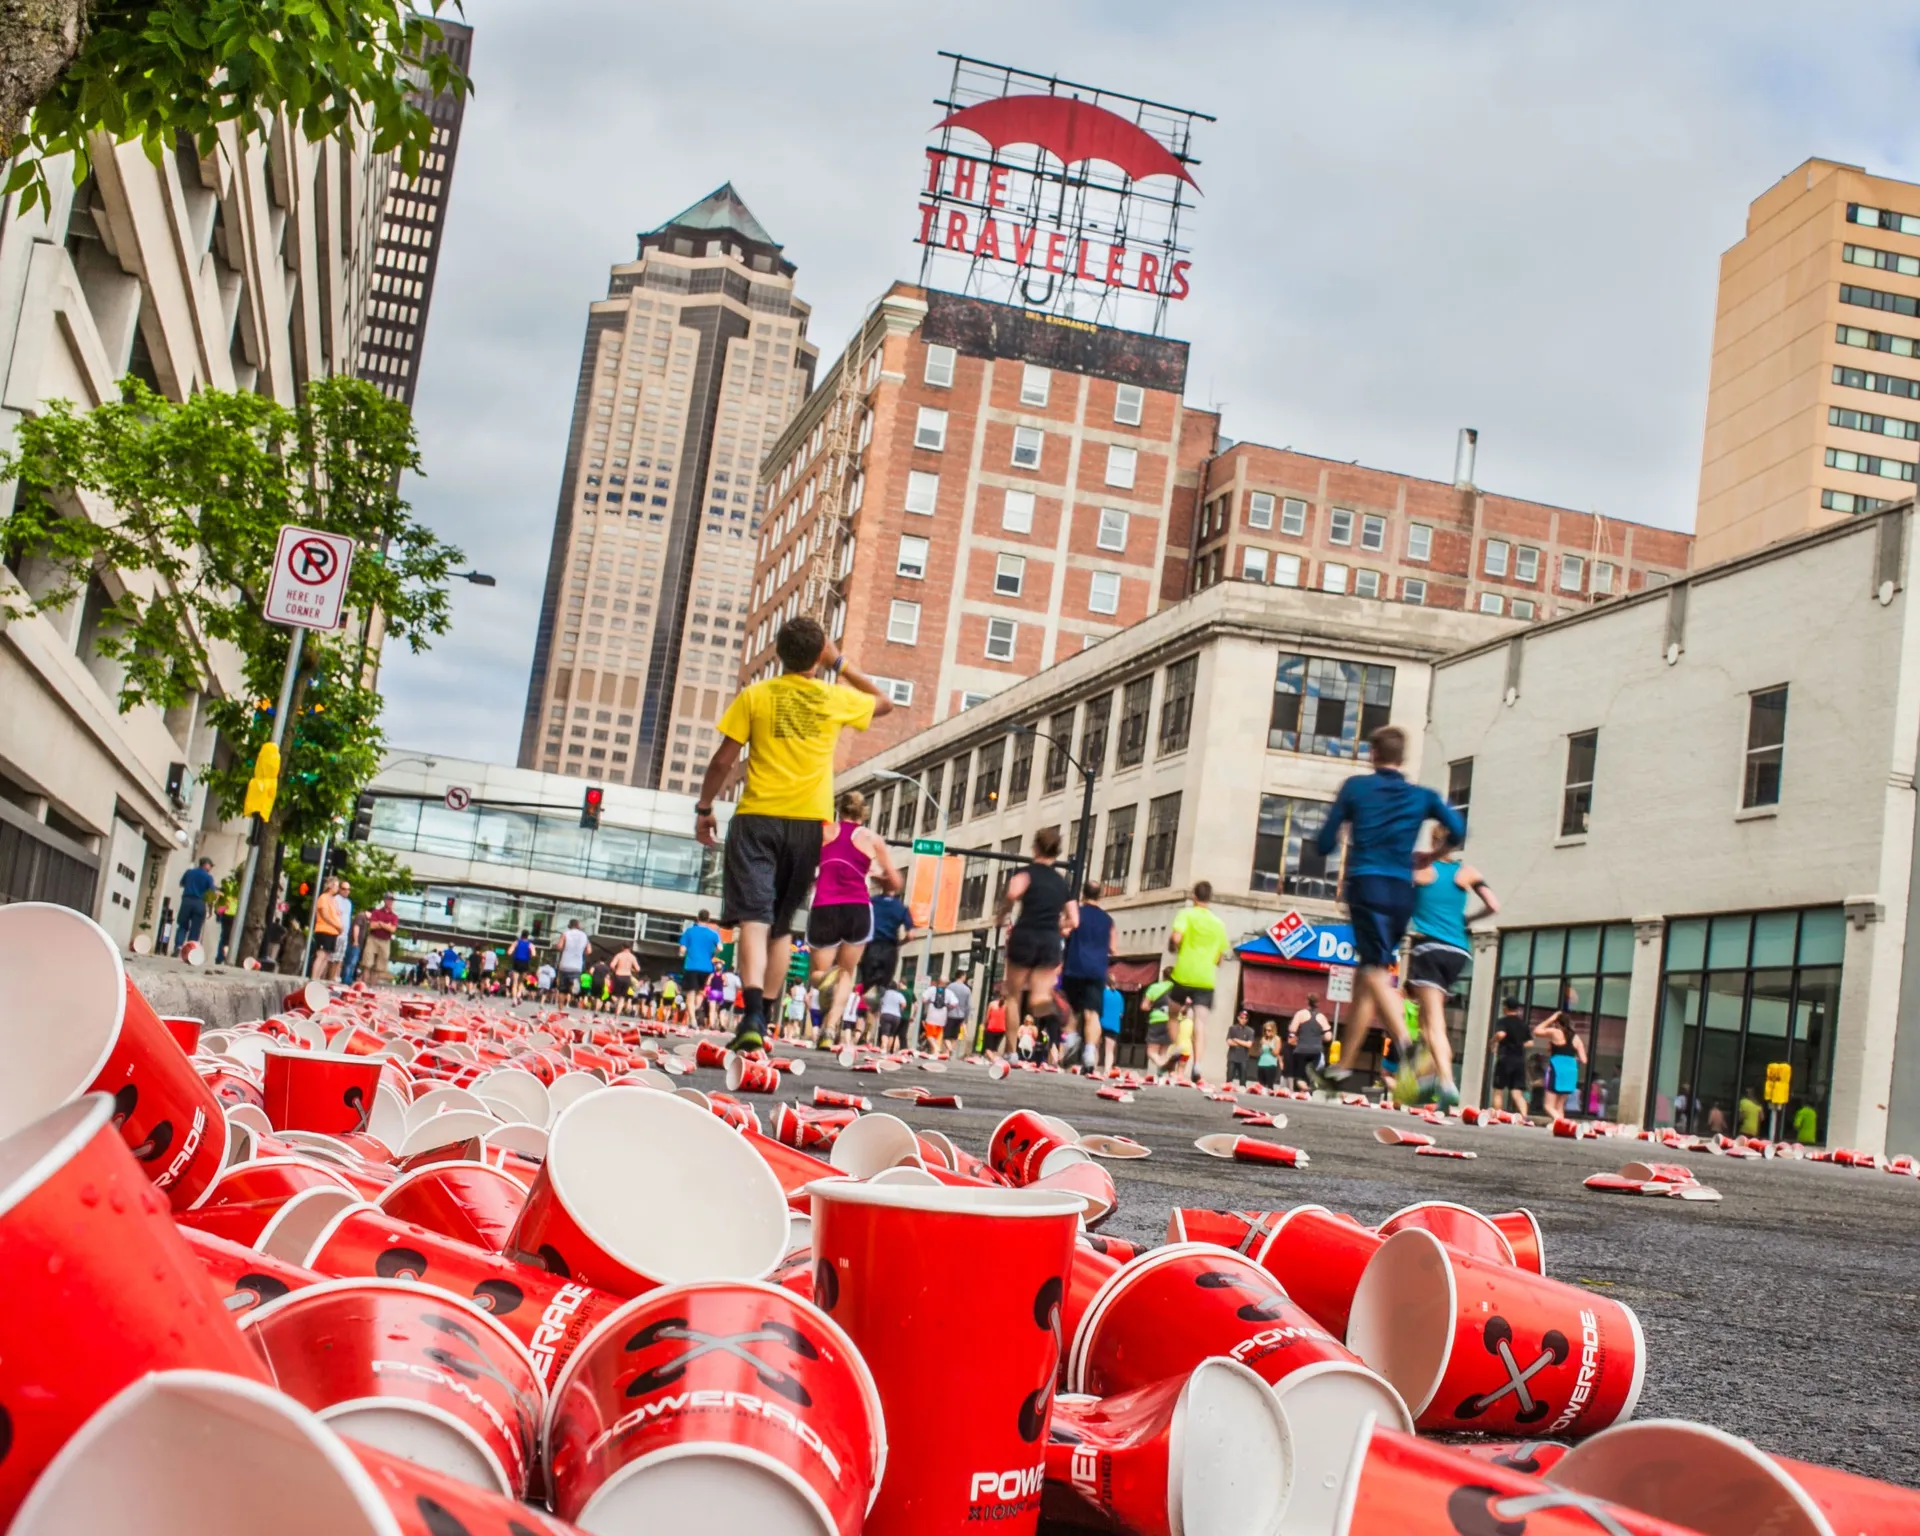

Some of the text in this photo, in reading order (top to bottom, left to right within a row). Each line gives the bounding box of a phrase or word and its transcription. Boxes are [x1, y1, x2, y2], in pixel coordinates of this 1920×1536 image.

[925, 150, 1009, 208] THE
[918, 202, 1193, 301] TRAVELERS
[285, 603, 321, 619] CORNER
[286, 589, 325, 606] HERE TO
[143, 861, 160, 920] ENTER
[1318, 931, 1360, 962] Do
[586, 1389, 842, 1482] POWERADE
